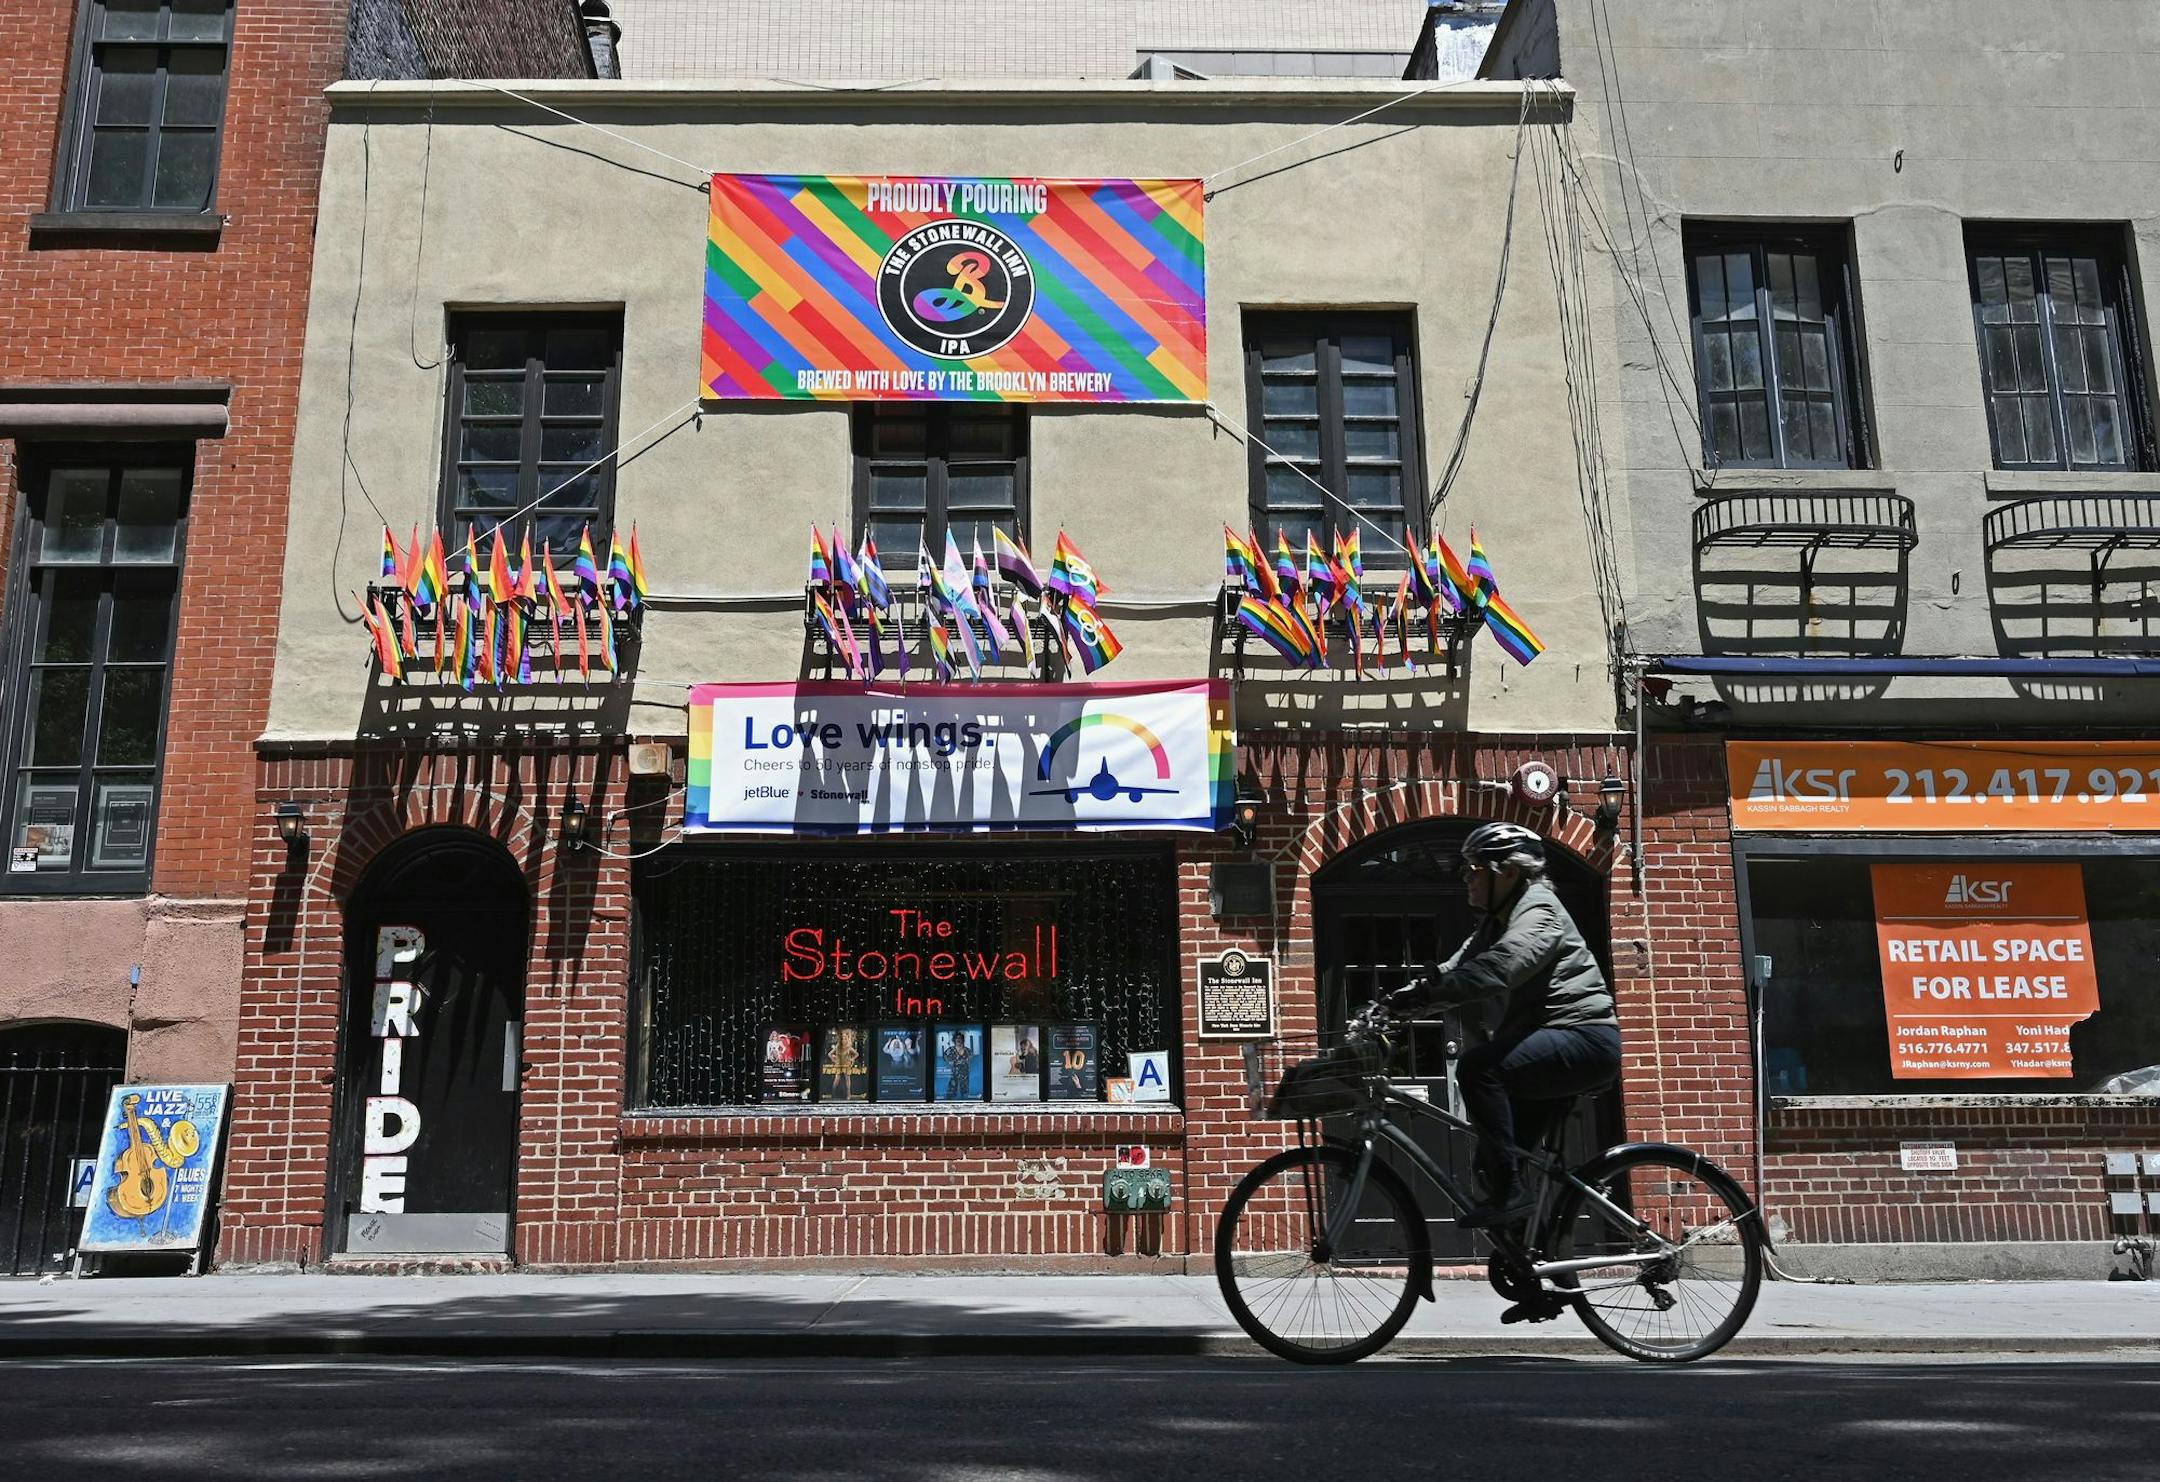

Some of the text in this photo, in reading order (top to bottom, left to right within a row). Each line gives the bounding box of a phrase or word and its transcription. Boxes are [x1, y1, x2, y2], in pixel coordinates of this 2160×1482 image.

[867, 183, 1048, 214] PROUDLY POURING
[885, 224, 1028, 278] THE STONEWALL INN
[940, 339, 970, 355] IPA
[797, 370, 1112, 393] BREWED WITH LOVE BY THE BROOKLYN BREWERY
[745, 714, 994, 757] Love wings.
[744, 758, 994, 774] Cheers to 50 years of nonstop pride.
[744, 786, 868, 800] jetBlue Stonewall
[1747, 805, 1850, 813] KASSIN SABBAGH REALTY
[890, 909, 952, 938] The
[783, 924, 1057, 982] Stonewall
[1888, 939, 2084, 962] RETAIL SPACE
[1912, 976, 2068, 999] FOR LEASE
[896, 987, 944, 1016] Inn
[1896, 1025, 1987, 1038] Jordan Raphan
[2016, 1025, 2070, 1036] Yoni Had
[1899, 1043, 1988, 1054] 516.776.4771
[360, 926, 426, 1214] PRIDE
[1138, 1059, 1163, 1087] A
[1902, 1059, 1990, 1069] JRaphan@ksrny.com
[146, 1090, 183, 1103] LIVE
[144, 1103, 187, 1116] JAZZ
[161, 1117, 171, 1128] &
[75, 1166, 95, 1192] A
[177, 1168, 206, 1182] BLUES
